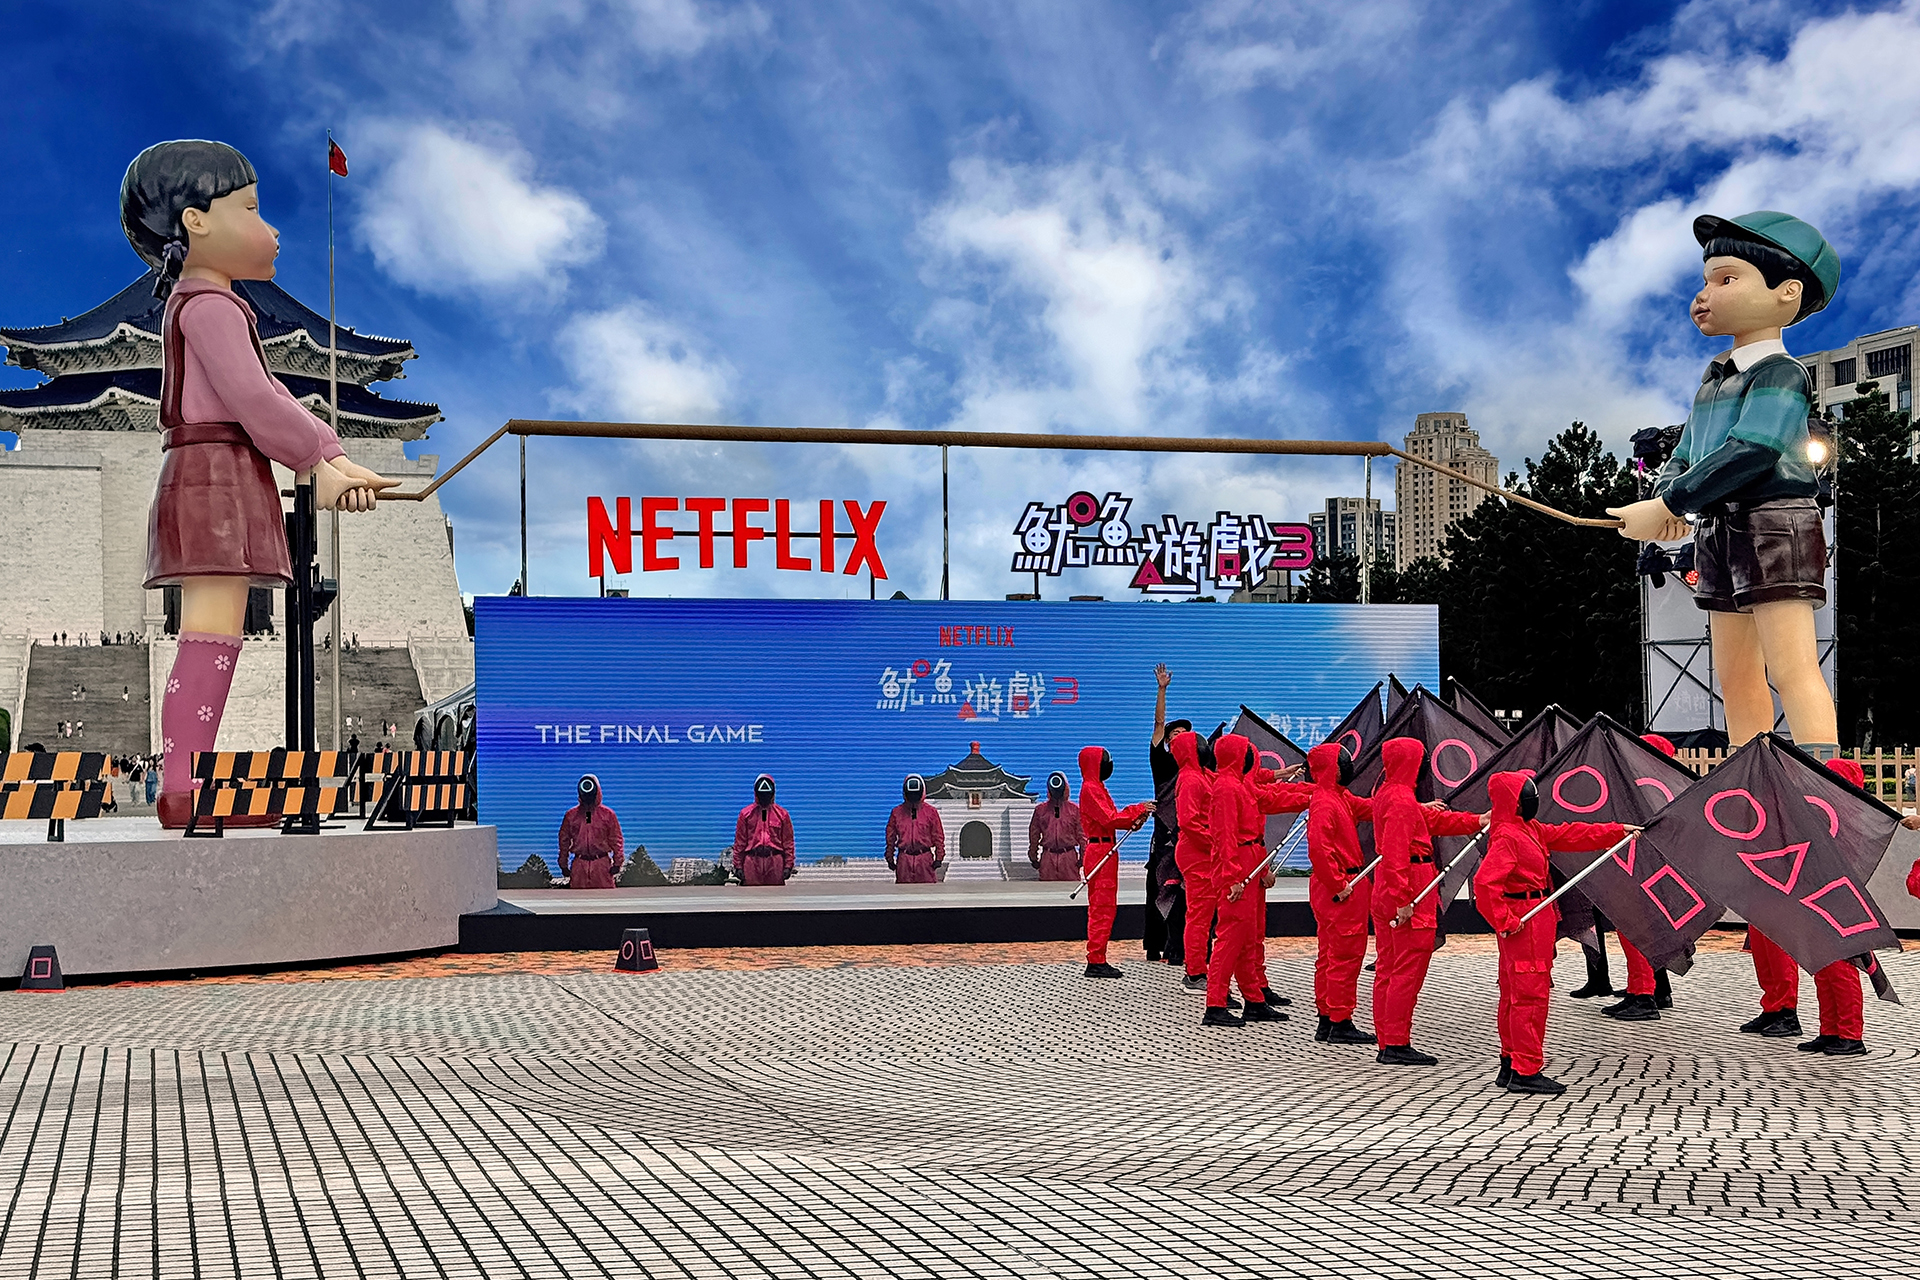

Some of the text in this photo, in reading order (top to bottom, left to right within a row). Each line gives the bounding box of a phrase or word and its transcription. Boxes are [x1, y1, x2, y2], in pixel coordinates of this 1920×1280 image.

[587, 496, 888, 579] NETFLIX
[939, 625, 1016, 647] NETFLIX
[534, 724, 765, 744] THE FINAL GAME
